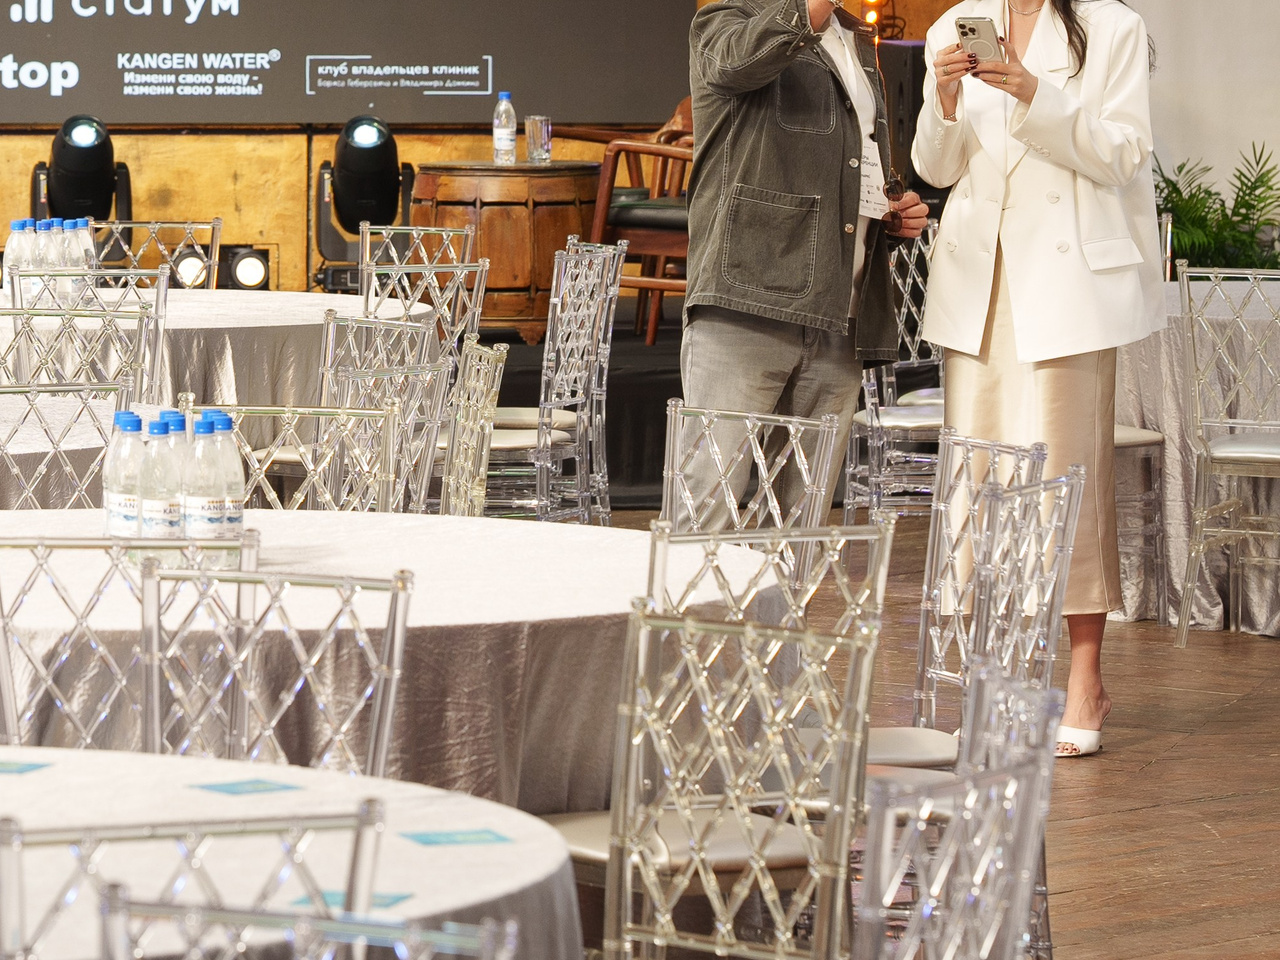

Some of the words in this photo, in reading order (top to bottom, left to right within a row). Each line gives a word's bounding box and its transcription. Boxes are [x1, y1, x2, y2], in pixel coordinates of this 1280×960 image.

[117, 53, 198, 69] KANGEN
[317, 62, 349, 77] клуб
[351, 65, 430, 75] владельцев
[432, 65, 480, 75] клиник
[123, 71, 176, 84] Измени
[178, 74, 215, 84] свою
[217, 74, 250, 86] воду
[123, 85, 174, 95] измени
[176, 85, 213, 95] свою
